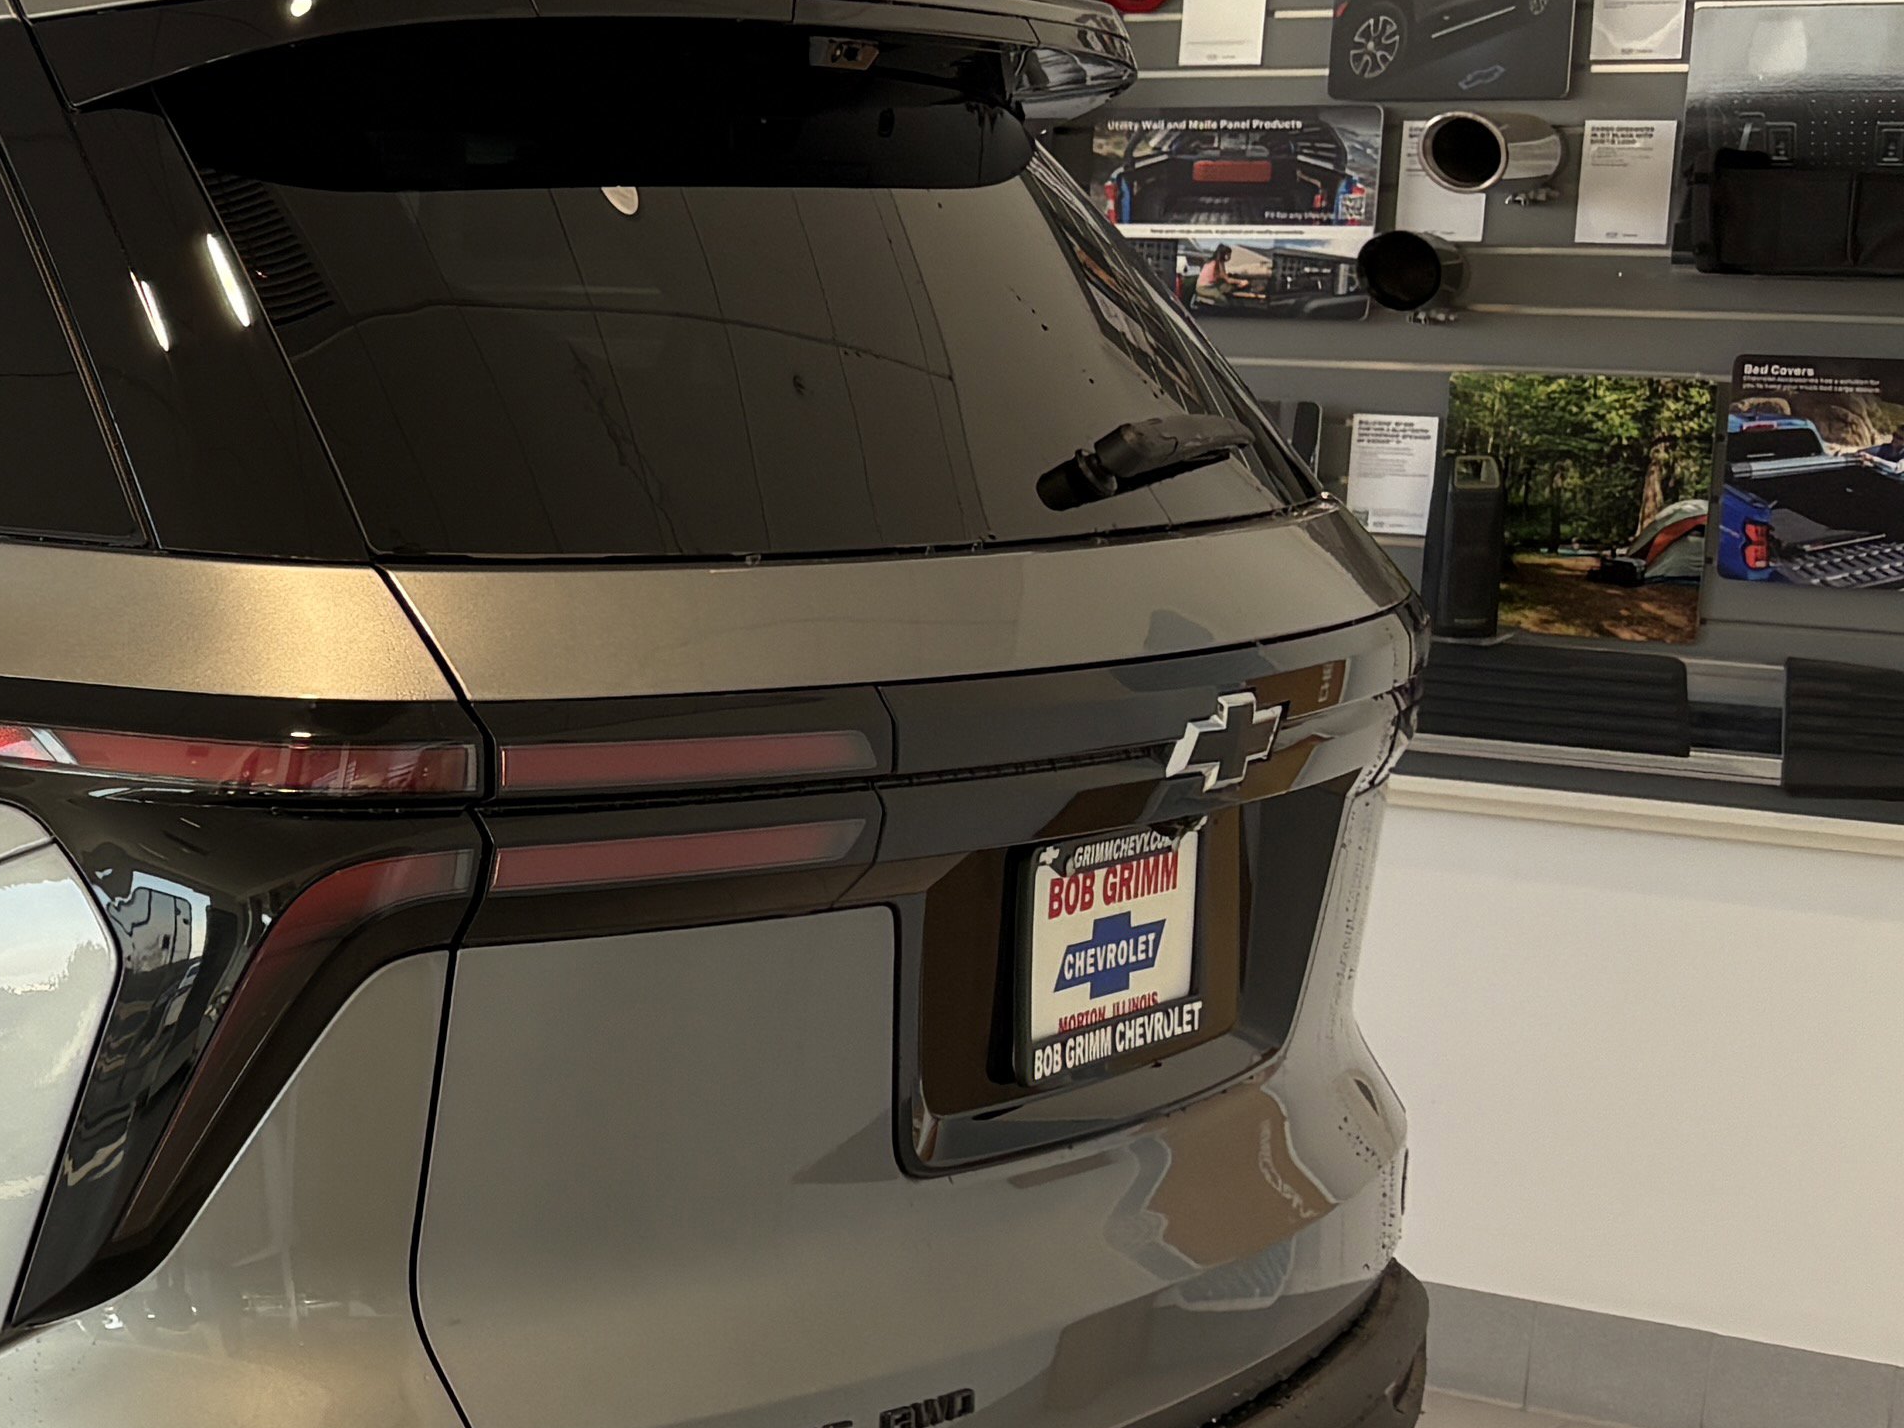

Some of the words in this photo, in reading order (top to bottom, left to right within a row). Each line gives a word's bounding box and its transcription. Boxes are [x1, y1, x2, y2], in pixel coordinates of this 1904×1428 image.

[1107, 121, 1139, 132] Utility
[1142, 120, 1164, 130] Wall
[1166, 120, 1186, 130] and
[1220, 119, 1250, 130] Panel
[1252, 119, 1303, 130] Products
[1743, 363, 1769, 375] Bed
[1771, 364, 1815, 377] Covers
[1048, 872, 1096, 920] BOB
[1102, 851, 1179, 906] GRIMM
[1063, 932, 1156, 981] CHEVROLET
[1112, 991, 1159, 1019] ILLINOIS
[1034, 1041, 1063, 1081] BOB
[1065, 1025, 1113, 1070] GRIMM
[1115, 1000, 1203, 1053] CHEVROLET
